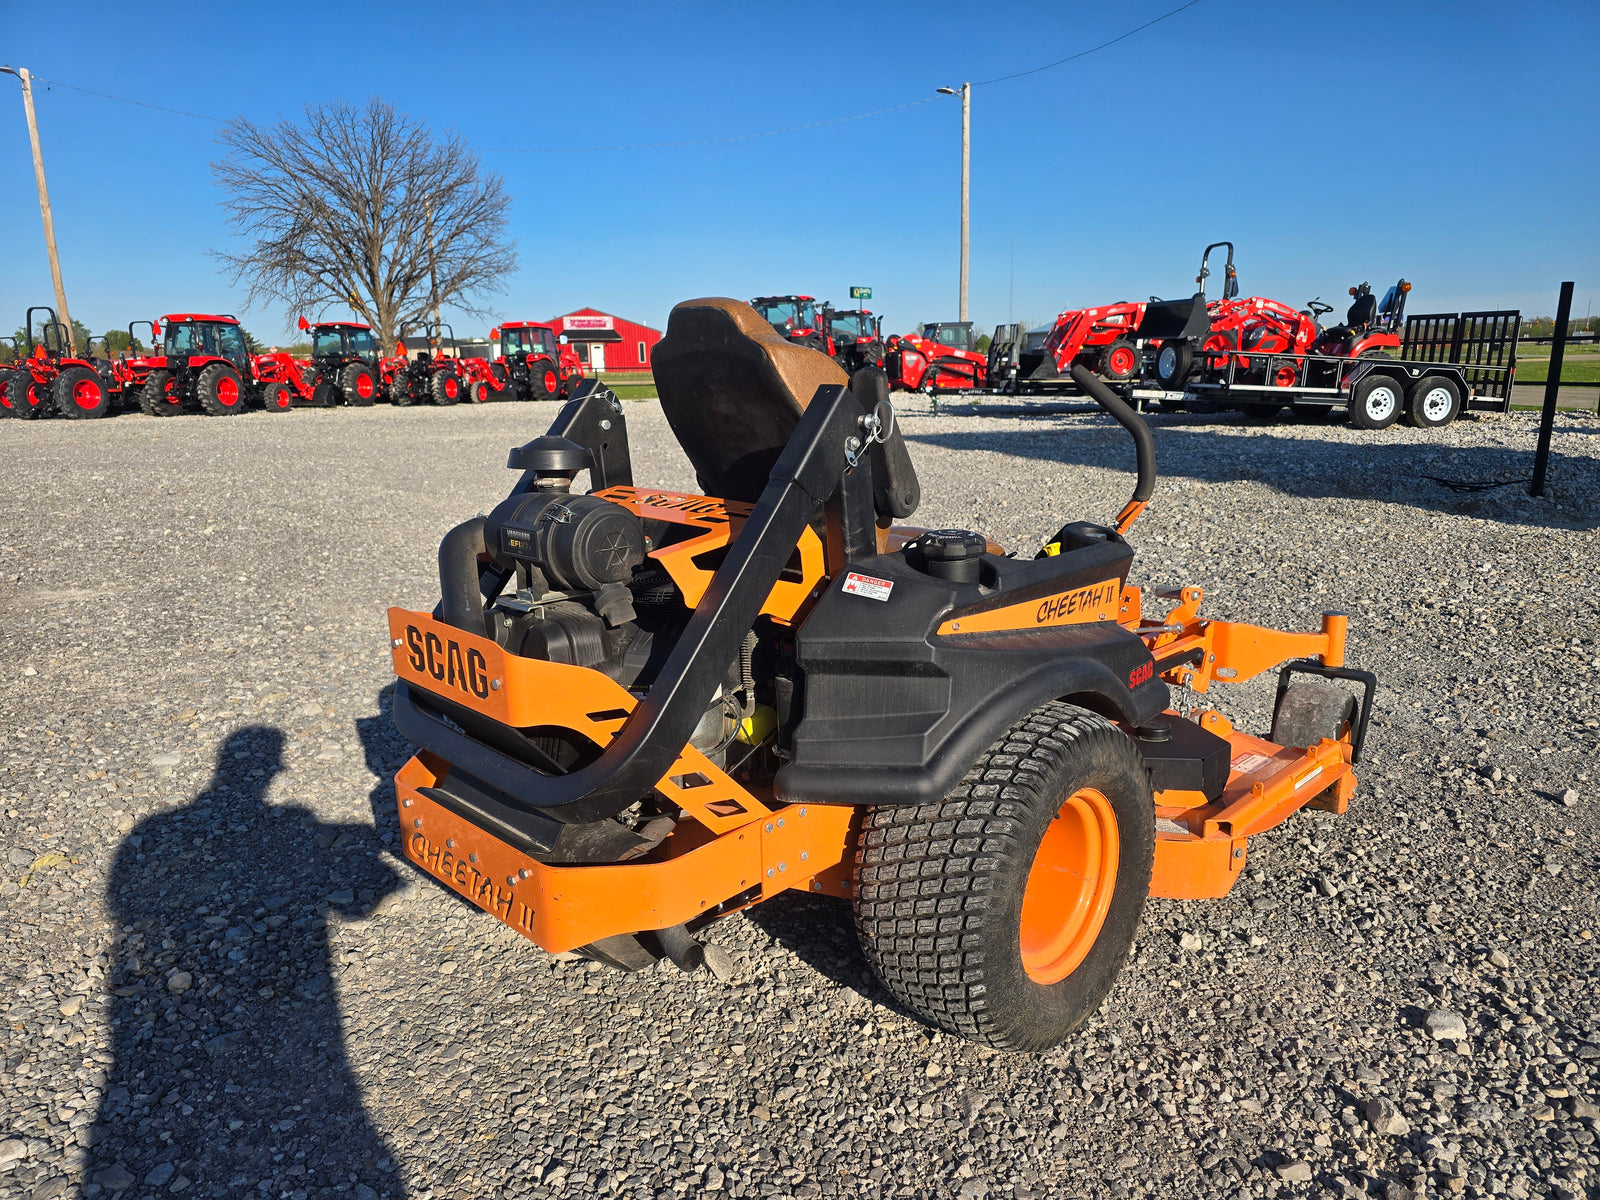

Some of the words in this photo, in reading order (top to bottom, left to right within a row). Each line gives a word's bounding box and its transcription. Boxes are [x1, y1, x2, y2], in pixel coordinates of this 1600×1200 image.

[862, 576, 886, 586] DANGER
[1036, 585, 1104, 623] CHEETAH
[1104, 585, 1114, 603] II
[406, 625, 489, 699] SCAG
[1129, 660, 1154, 689] SCAG
[408, 832, 514, 920] CHEETAH
[519, 902, 536, 935] II
